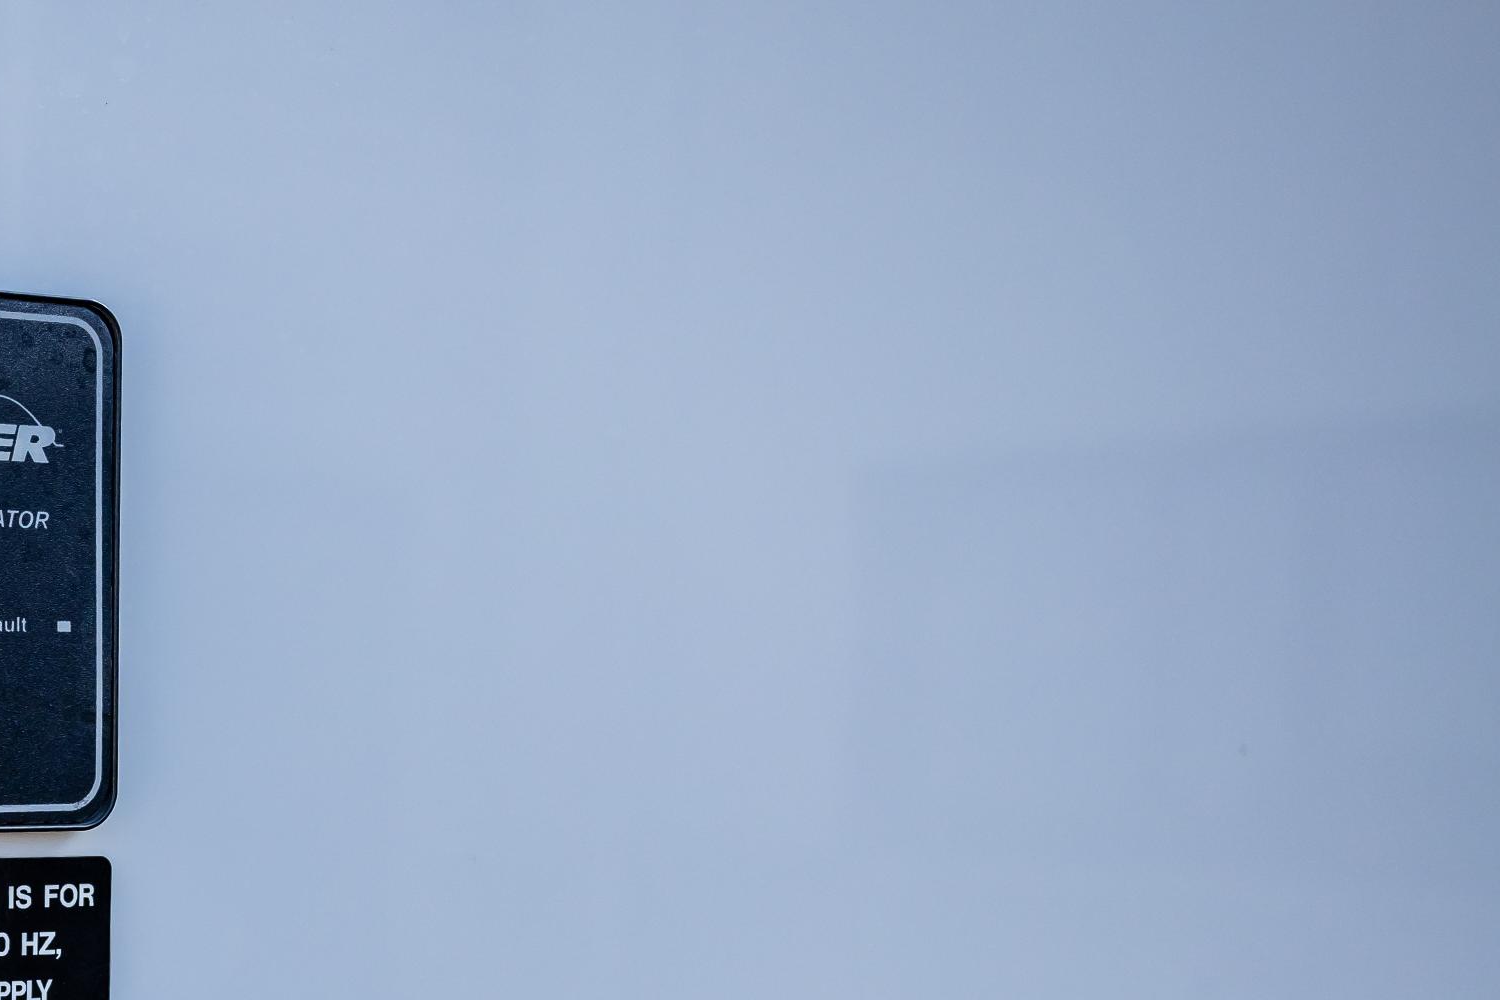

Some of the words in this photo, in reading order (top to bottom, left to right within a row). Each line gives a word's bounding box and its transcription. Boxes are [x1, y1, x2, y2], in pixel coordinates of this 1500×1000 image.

[8, 885, 33, 910] IS
[44, 883, 95, 908] FOR
[21, 931, 62, 960] HZ,
